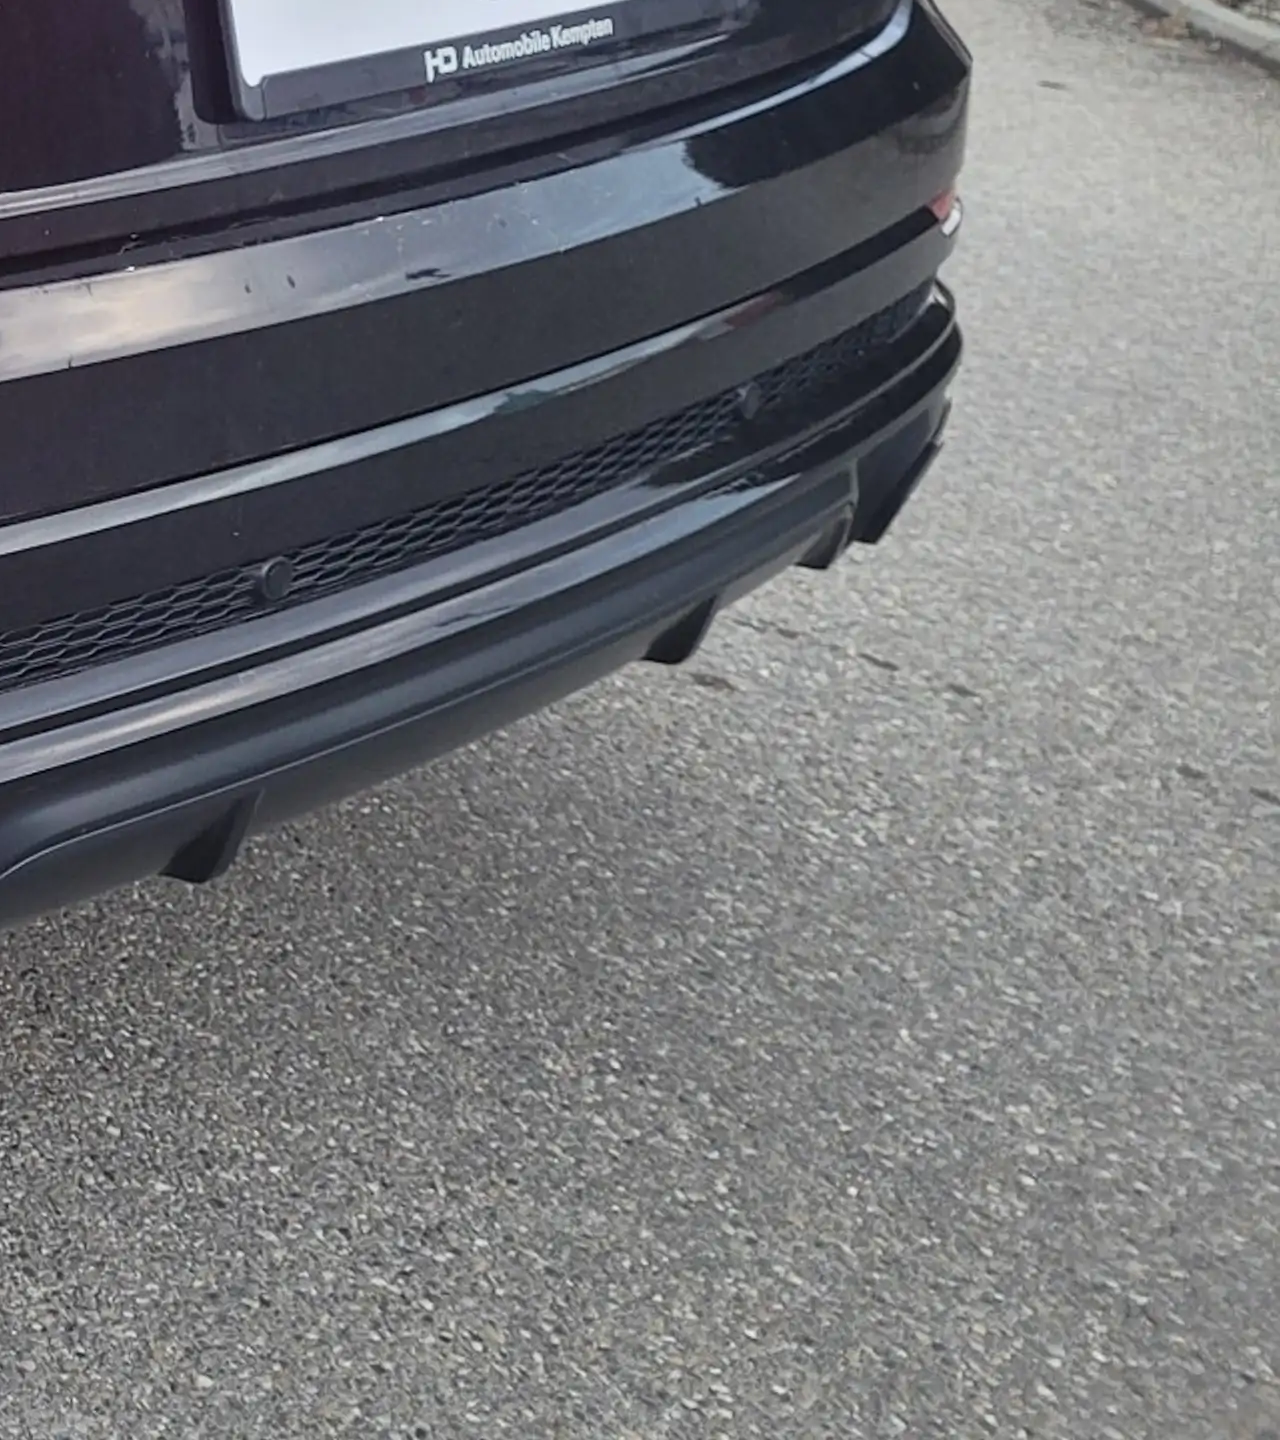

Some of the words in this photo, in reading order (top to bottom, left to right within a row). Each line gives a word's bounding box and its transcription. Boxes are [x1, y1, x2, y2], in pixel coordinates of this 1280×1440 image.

[424, 46, 458, 83] HD
[462, 30, 551, 69] Automobile
[550, 17, 613, 48] Kempten
